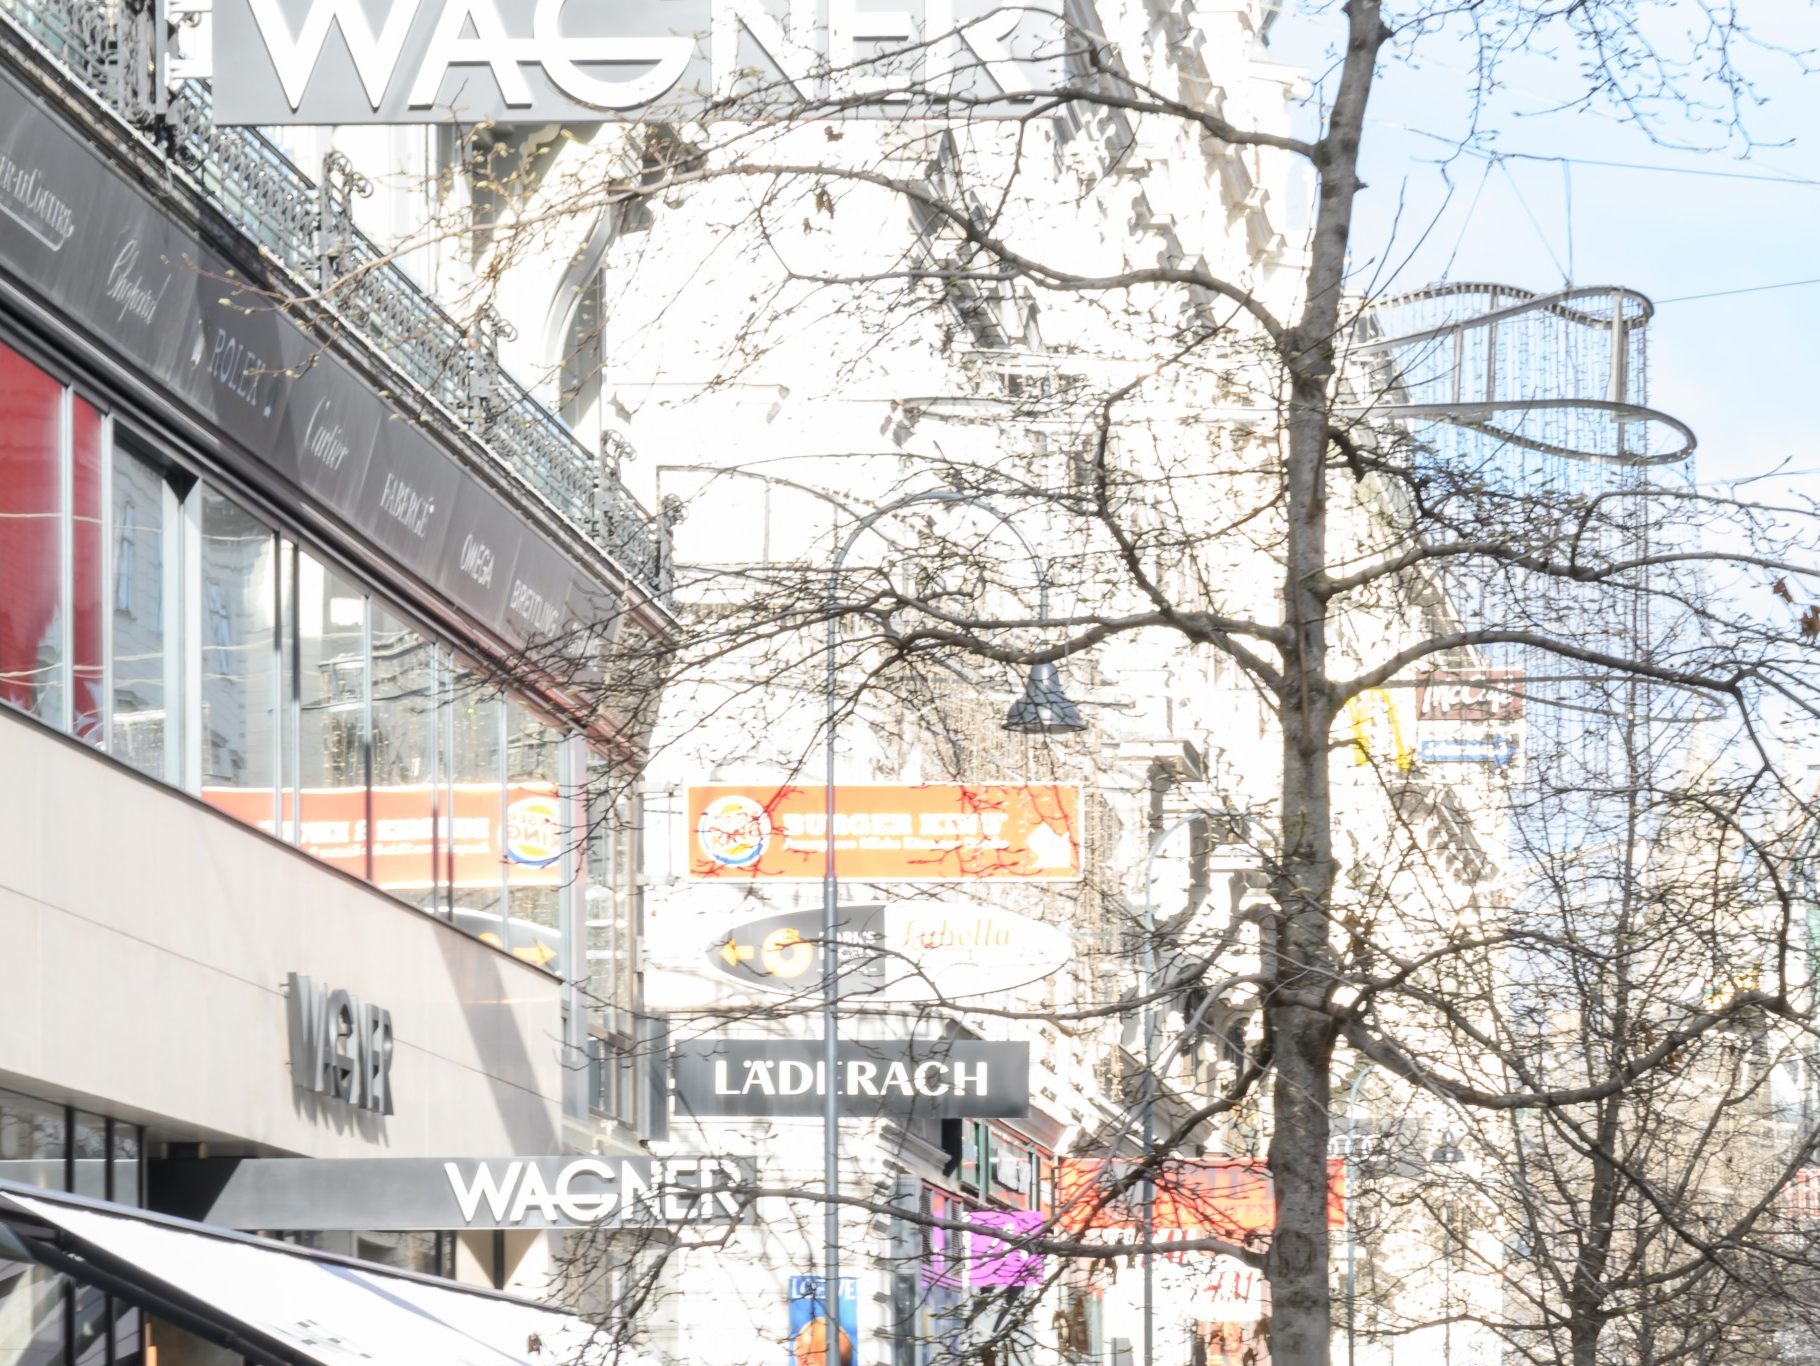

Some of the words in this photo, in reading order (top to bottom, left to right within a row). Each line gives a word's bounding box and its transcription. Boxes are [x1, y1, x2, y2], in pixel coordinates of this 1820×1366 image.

[207, 328, 267, 408] ROLEX
[460, 533, 496, 590] OMEGA
[443, 1158, 745, 1223] WAGNER
